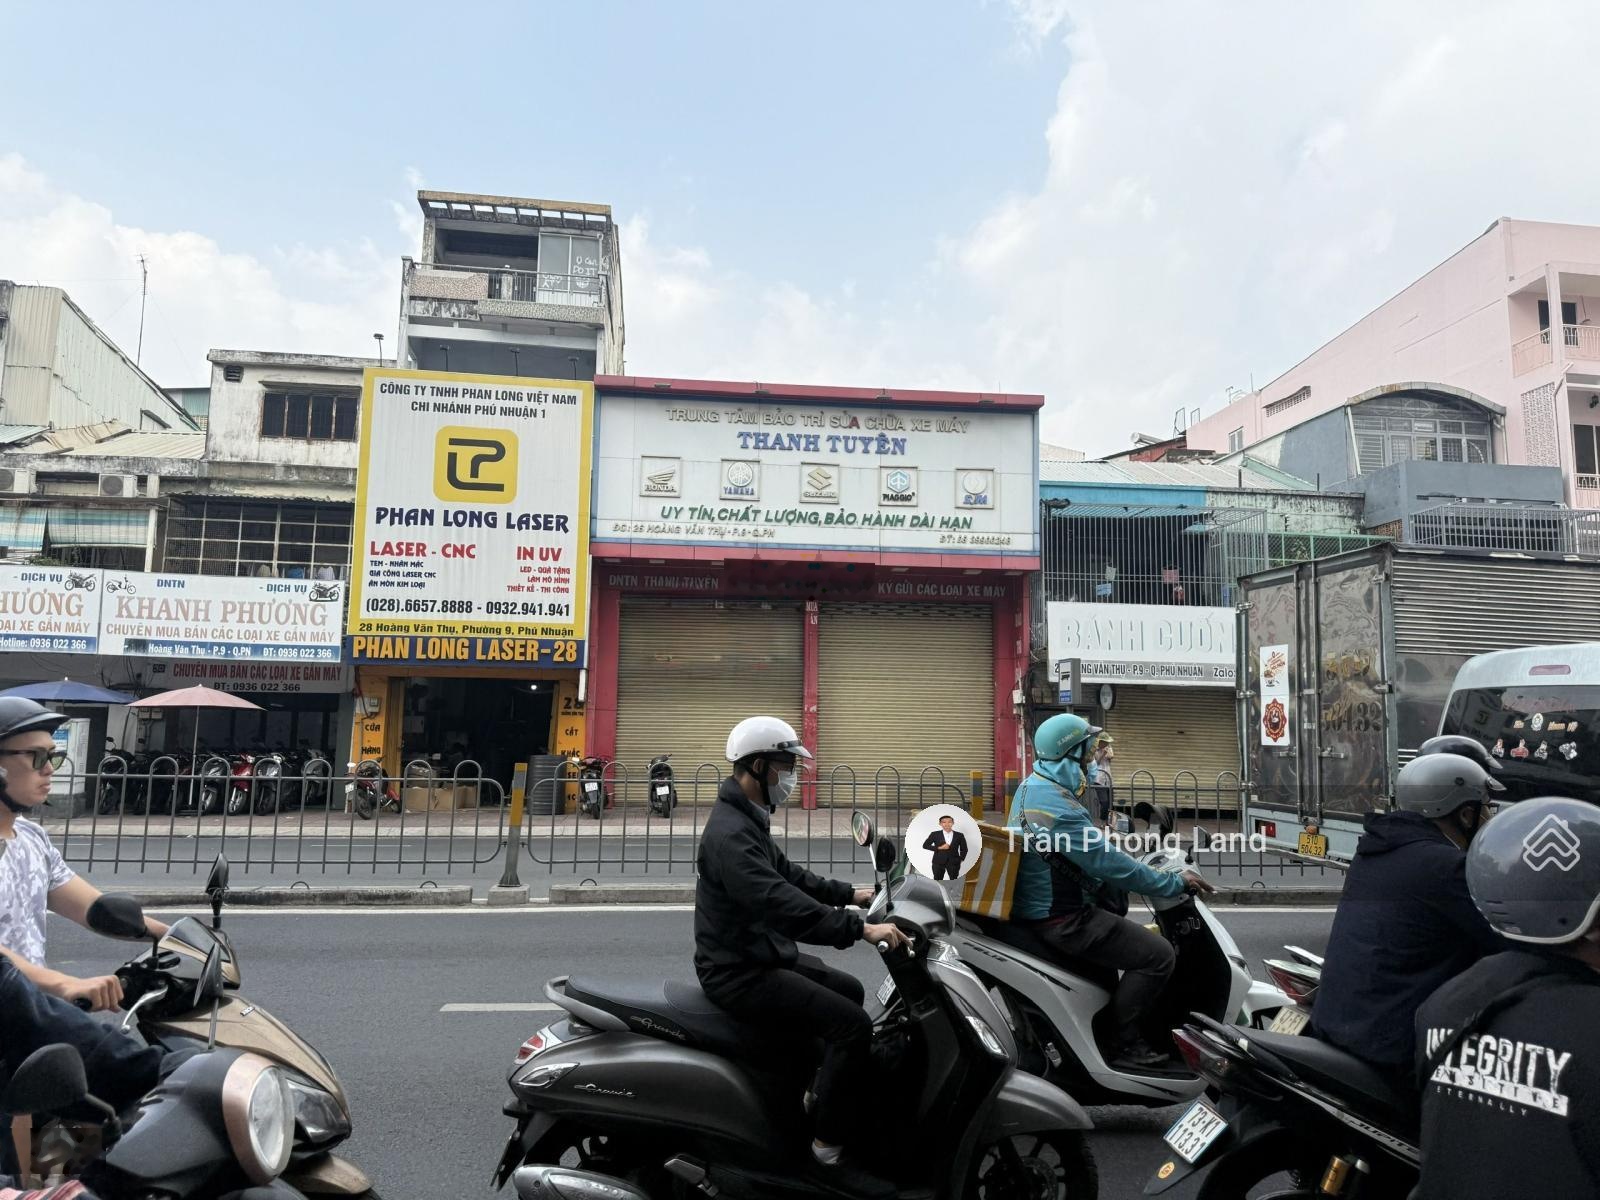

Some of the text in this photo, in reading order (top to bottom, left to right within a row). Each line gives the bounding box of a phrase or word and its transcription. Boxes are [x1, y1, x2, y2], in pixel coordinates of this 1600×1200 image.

[380, 382, 576, 406] CÔNG TY TNHH PHAN LONG VIỆT NAM
[411, 401, 546, 420] CHI NHÁNH PHÚ NHUẬN 1
[665, 408, 720, 423] TRUNG
[724, 408, 758, 424] TÂM
[762, 408, 796, 426] BẢO
[800, 410, 825, 427] TRÌ
[864, 413, 906, 431] CHỮA
[911, 418, 931, 432] XE
[936, 416, 970, 433] MÁY
[736, 431, 820, 452] THANH
[723, 486, 754, 496] YAMAHA
[376, 507, 569, 534] PHAN LONG LASER
[660, 506, 683, 519] UY
[861, 511, 905, 527] HÀNH
[910, 512, 935, 528] DÀI
[939, 516, 973, 532] HẠN
[370, 541, 476, 559] LASER CNC
[516, 546, 562, 561] IN UV
[21, 573, 62, 584] DỊCH VỤ
[157, 579, 185, 588] DNTN
[411, 581, 425, 589] LOẠI
[609, 574, 638, 587] DNTN
[266, 583, 307, 595] DỊCH VỤ
[878, 579, 893, 595] KÝ
[917, 581, 938, 595] CÁC
[940, 584, 962, 599] LOẠI
[967, 585, 981, 596] XE
[983, 583, 1006, 597] MÁY
[115, 595, 328, 626] KHANH PHƯƠNG
[366, 598, 570, 617] (028).6657.8888 0932.941.941
[805, 601, 818, 612] MUA
[19, 616, 90, 633] XE GẮN MÁY
[106, 622, 335, 643] CHUYÊN MUA BÁN CÁC LOẠI XE GẮN MÁY
[359, 623, 372, 632] 28
[376, 623, 410, 634] Hoàng
[413, 623, 433, 633] Văn
[437, 624, 458, 635] Thụ,
[462, 624, 501, 636] Phường
[517, 625, 537, 635] Phú
[541, 627, 574, 638] Nhuận
[1062, 611, 1235, 652] BÁNH CUỐN
[30, 638, 50, 648] 0936
[53, 639, 68, 648] 022
[71, 639, 87, 649] 366
[149, 643, 332, 658] Hoàng Văn Thụ P.9 Q.PN ĐT: 0936 022 366
[352, 637, 410, 659] PHAN
[416, 638, 470, 660] LONG
[173, 661, 207, 678] CHUYÊN
[209, 664, 228, 678] MUA
[230, 662, 248, 678] BÁN
[250, 663, 267, 679] CÁC
[270, 665, 288, 683] LOẠI
[290, 666, 301, 680] XE
[303, 662, 320, 680] GẮN
[323, 664, 341, 681] MÁY
[1094, 661, 1109, 674] VĂN
[1112, 664, 1126, 678] THỤ
[1133, 665, 1144, 675] P.9
[1151, 666, 1159, 676] Q.
[1160, 664, 1175, 676] PHÚ
[1178, 665, 1203, 679] NHUẬN
[1213, 667, 1235, 678] Zalo:
[214, 682, 300, 692] ĐT: 0936 022 366
[1437, 1085, 1527, 1116] ETERNALLY
